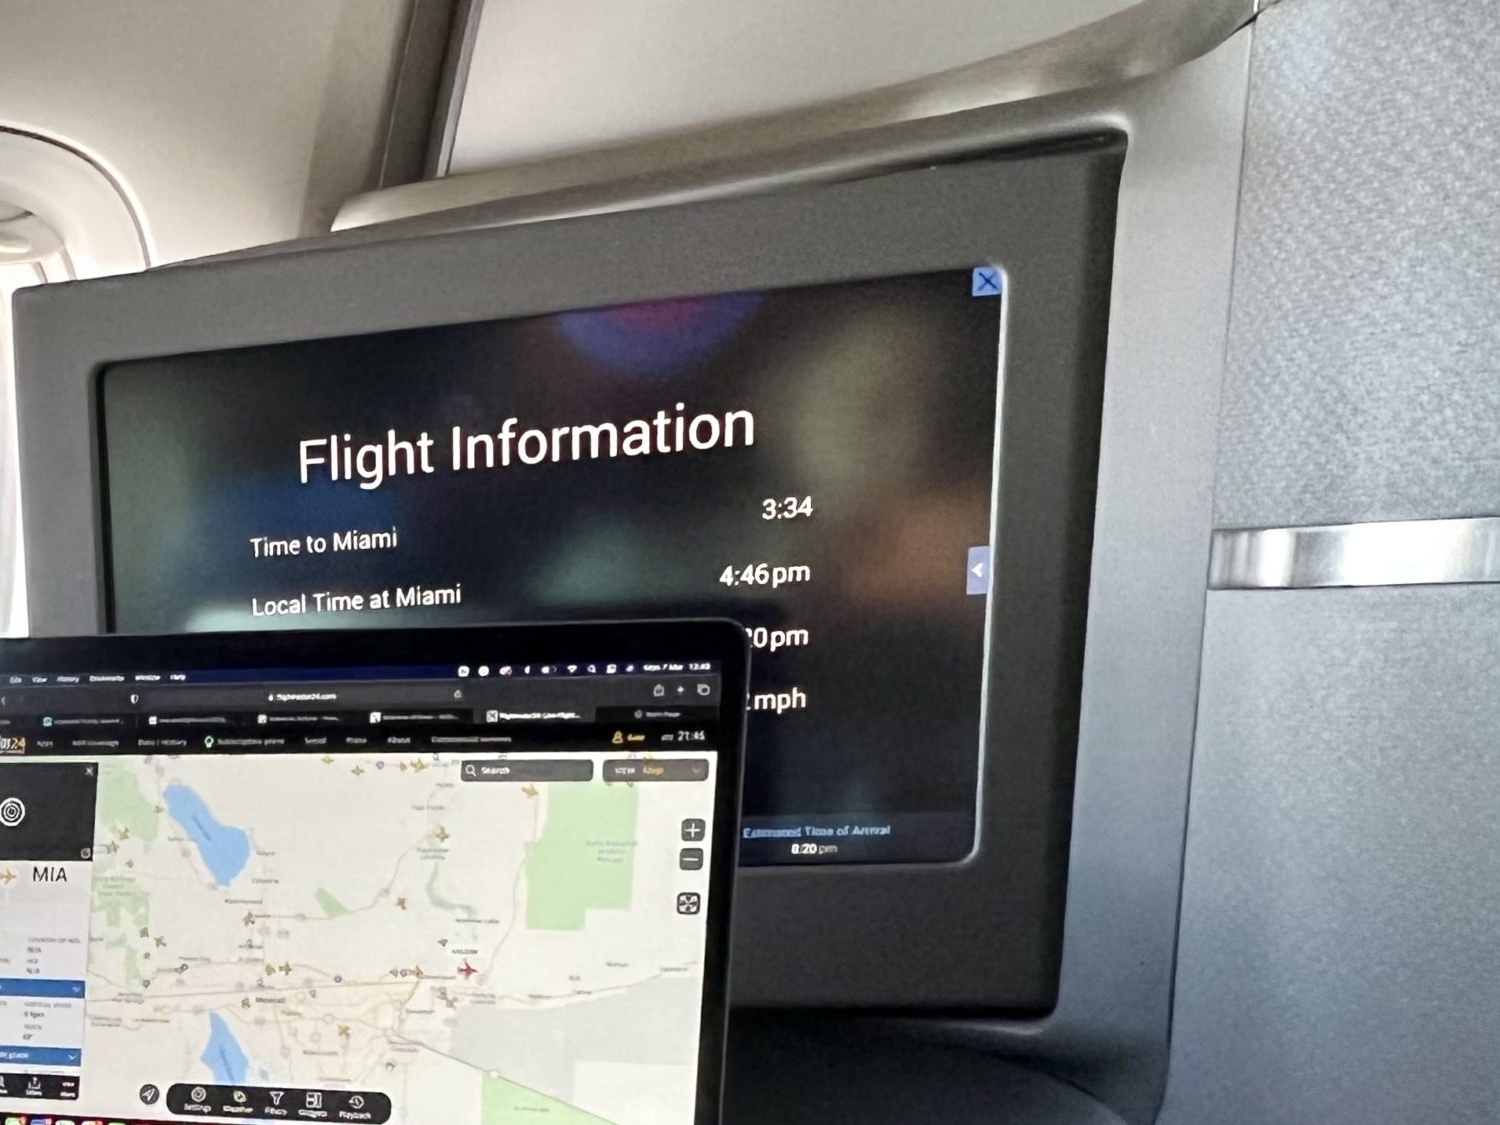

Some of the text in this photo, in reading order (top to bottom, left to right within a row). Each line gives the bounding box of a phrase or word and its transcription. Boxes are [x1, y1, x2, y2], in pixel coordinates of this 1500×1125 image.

[299, 401, 755, 490] Flight Information
[761, 496, 814, 520] 3:34
[250, 526, 398, 558] Time to Miami
[251, 583, 461, 616] Local Time at Miami
[753, 686, 807, 714] mph
[804, 825, 834, 836] Time
[32, 865, 68, 883] MIA
